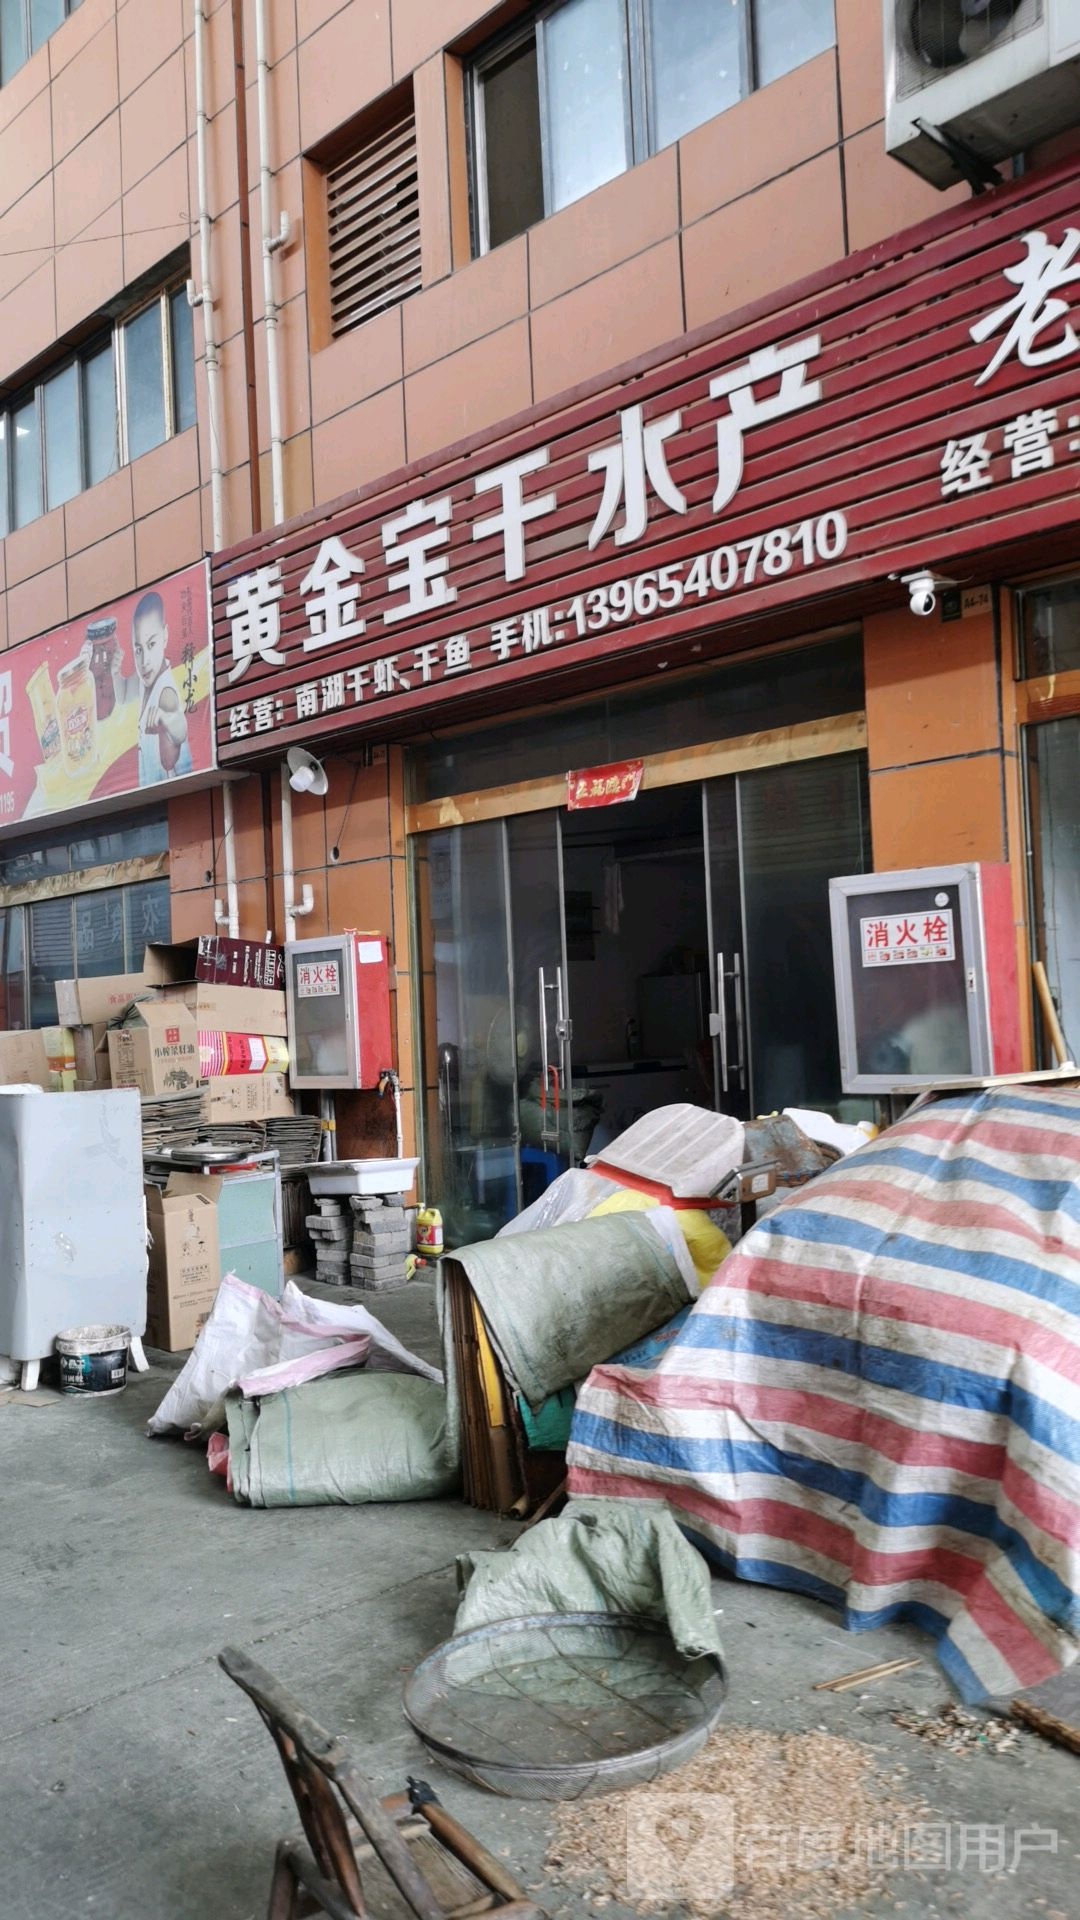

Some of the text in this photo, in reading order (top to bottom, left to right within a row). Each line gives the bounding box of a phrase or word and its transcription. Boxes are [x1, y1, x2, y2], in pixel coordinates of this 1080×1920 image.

[227, 333, 822, 684] 黄金宝干水产
[865, 915, 949, 948] 消火栓
[300, 964, 337, 985] 消火栓
